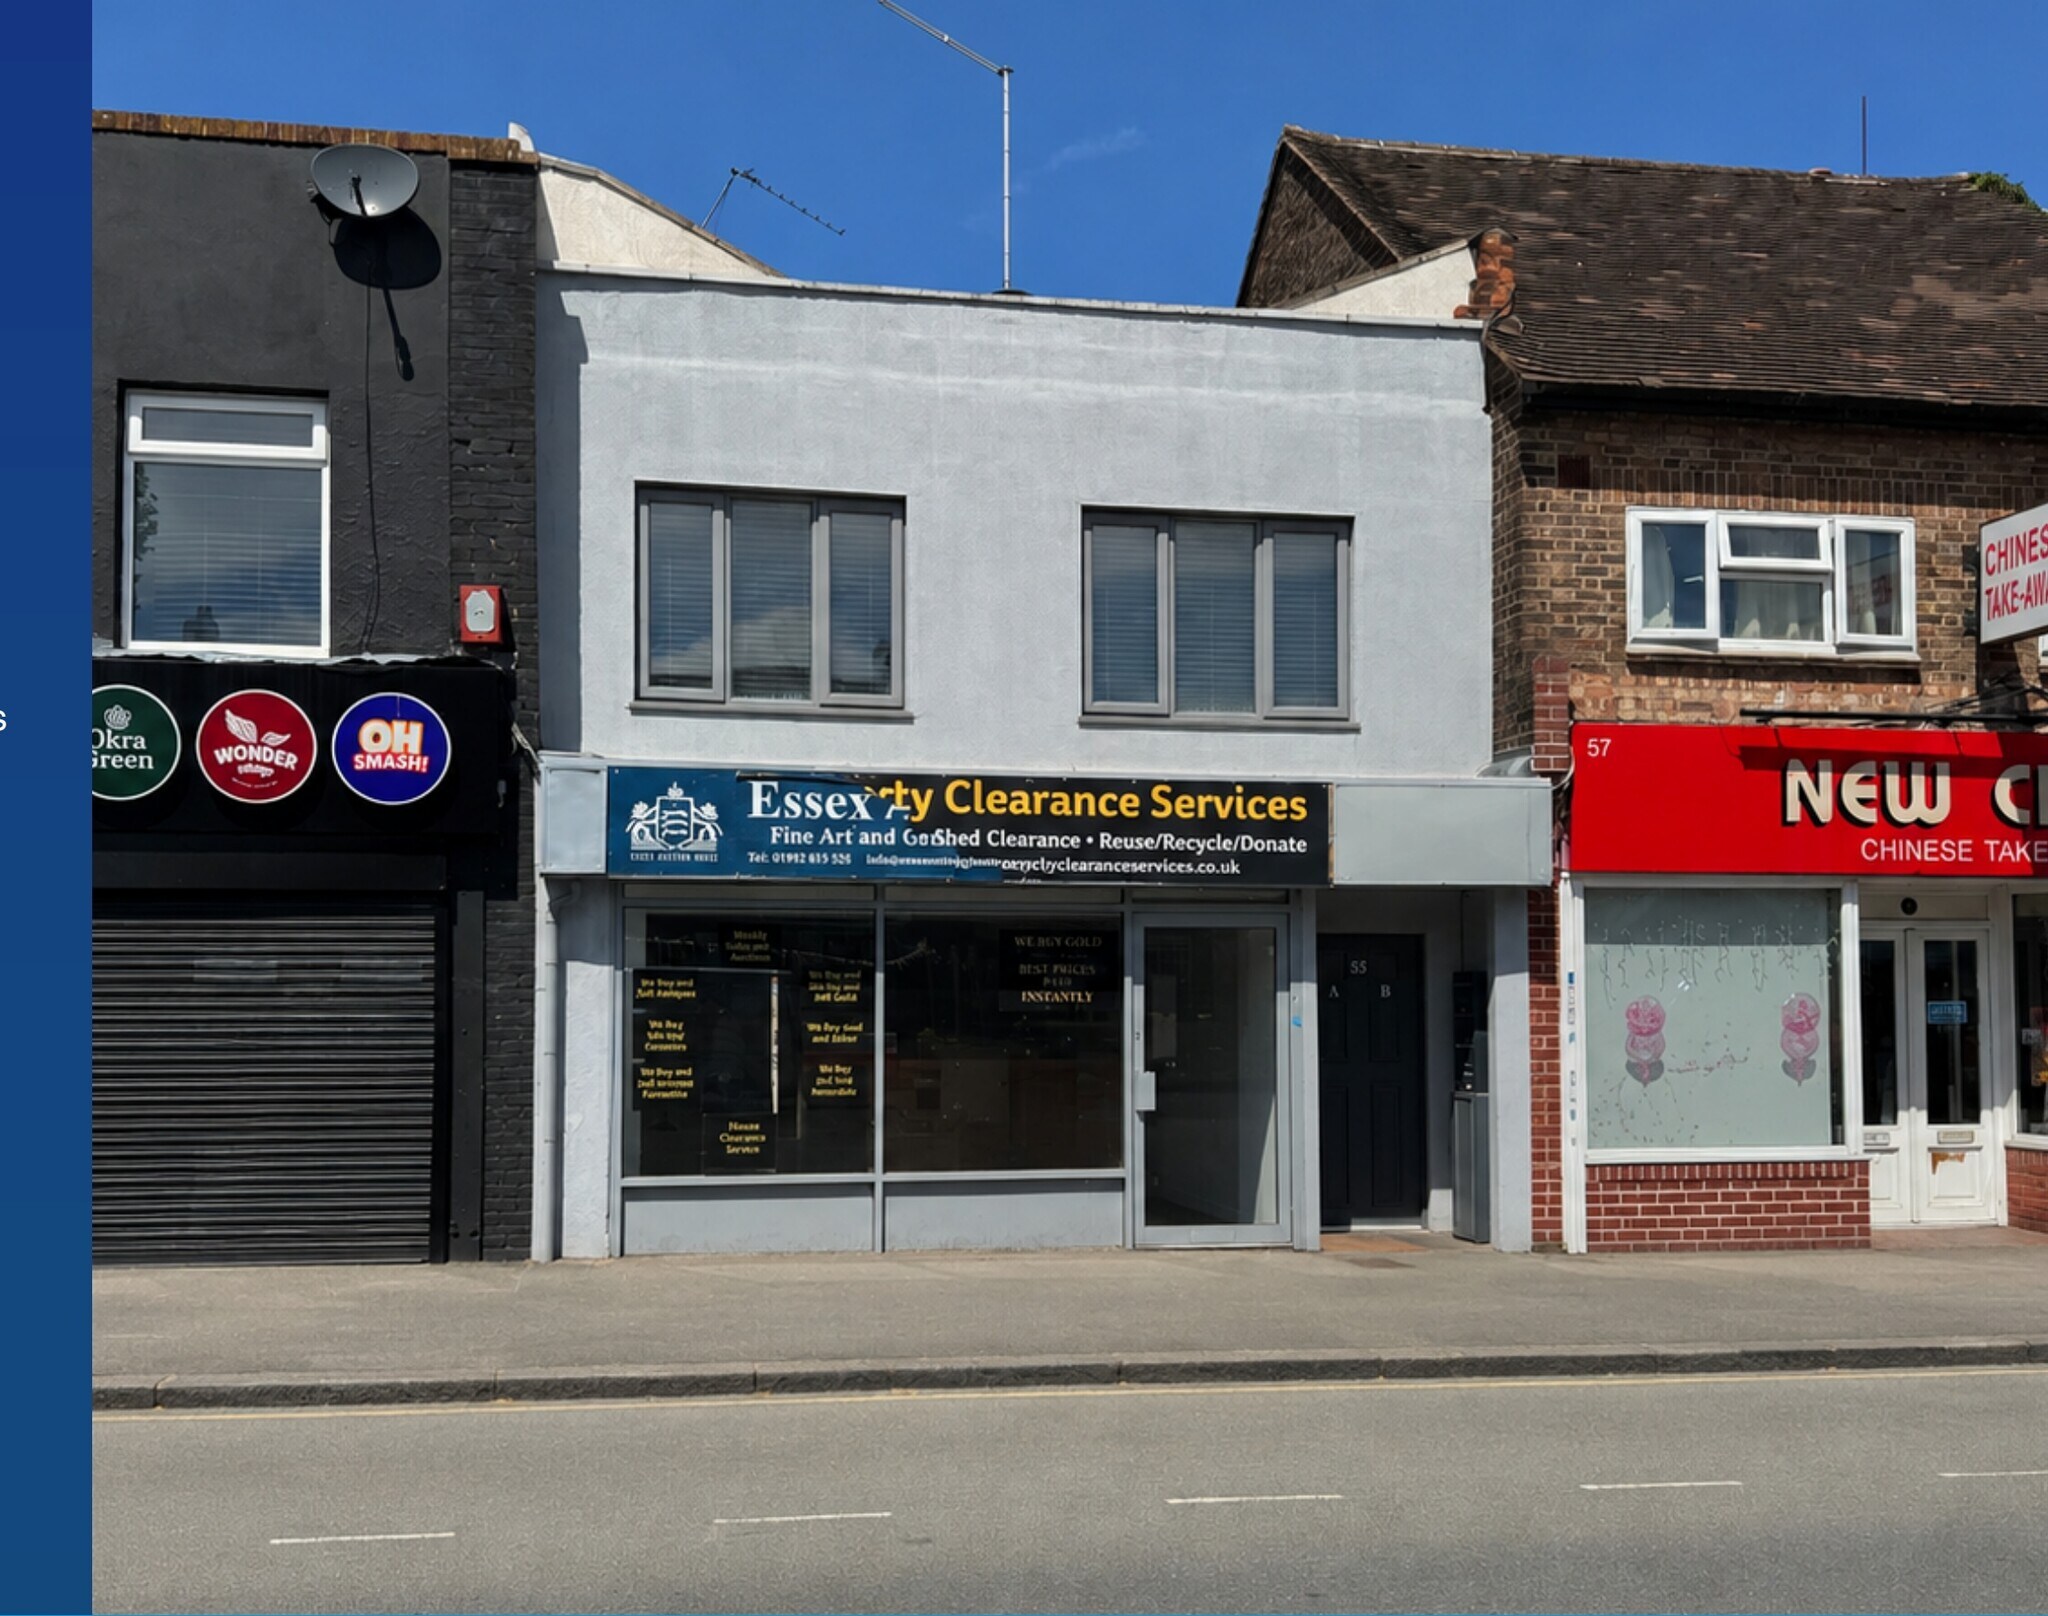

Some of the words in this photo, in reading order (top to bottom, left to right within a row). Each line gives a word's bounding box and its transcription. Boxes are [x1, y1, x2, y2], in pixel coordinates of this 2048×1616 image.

[1985, 571, 2048, 621] TAKE-AW
[92, 727, 147, 750] Okra
[358, 718, 424, 754] OH
[1587, 738, 1612, 757] 57
[213, 744, 298, 771] WONDER
[353, 753, 429, 773] SMASH!
[747, 780, 875, 821] Essex
[944, 778, 1140, 818] Clearance
[1150, 784, 1308, 820] Services
[1784, 758, 1951, 827] NEW
[770, 826, 814, 845] Fine
[818, 827, 852, 846] Art
[858, 828, 896, 846] and
[987, 829, 1081, 850] Clearance
[1099, 832, 1308, 855] Reuse/Recycle/Donate
[1861, 838, 1973, 862] CHINESE
[1065, 936, 1103, 948] GOLD
[1021, 990, 1094, 1004] INSTANTLY
[1329, 984, 1340, 998] A
[1380, 984, 1392, 998] B
